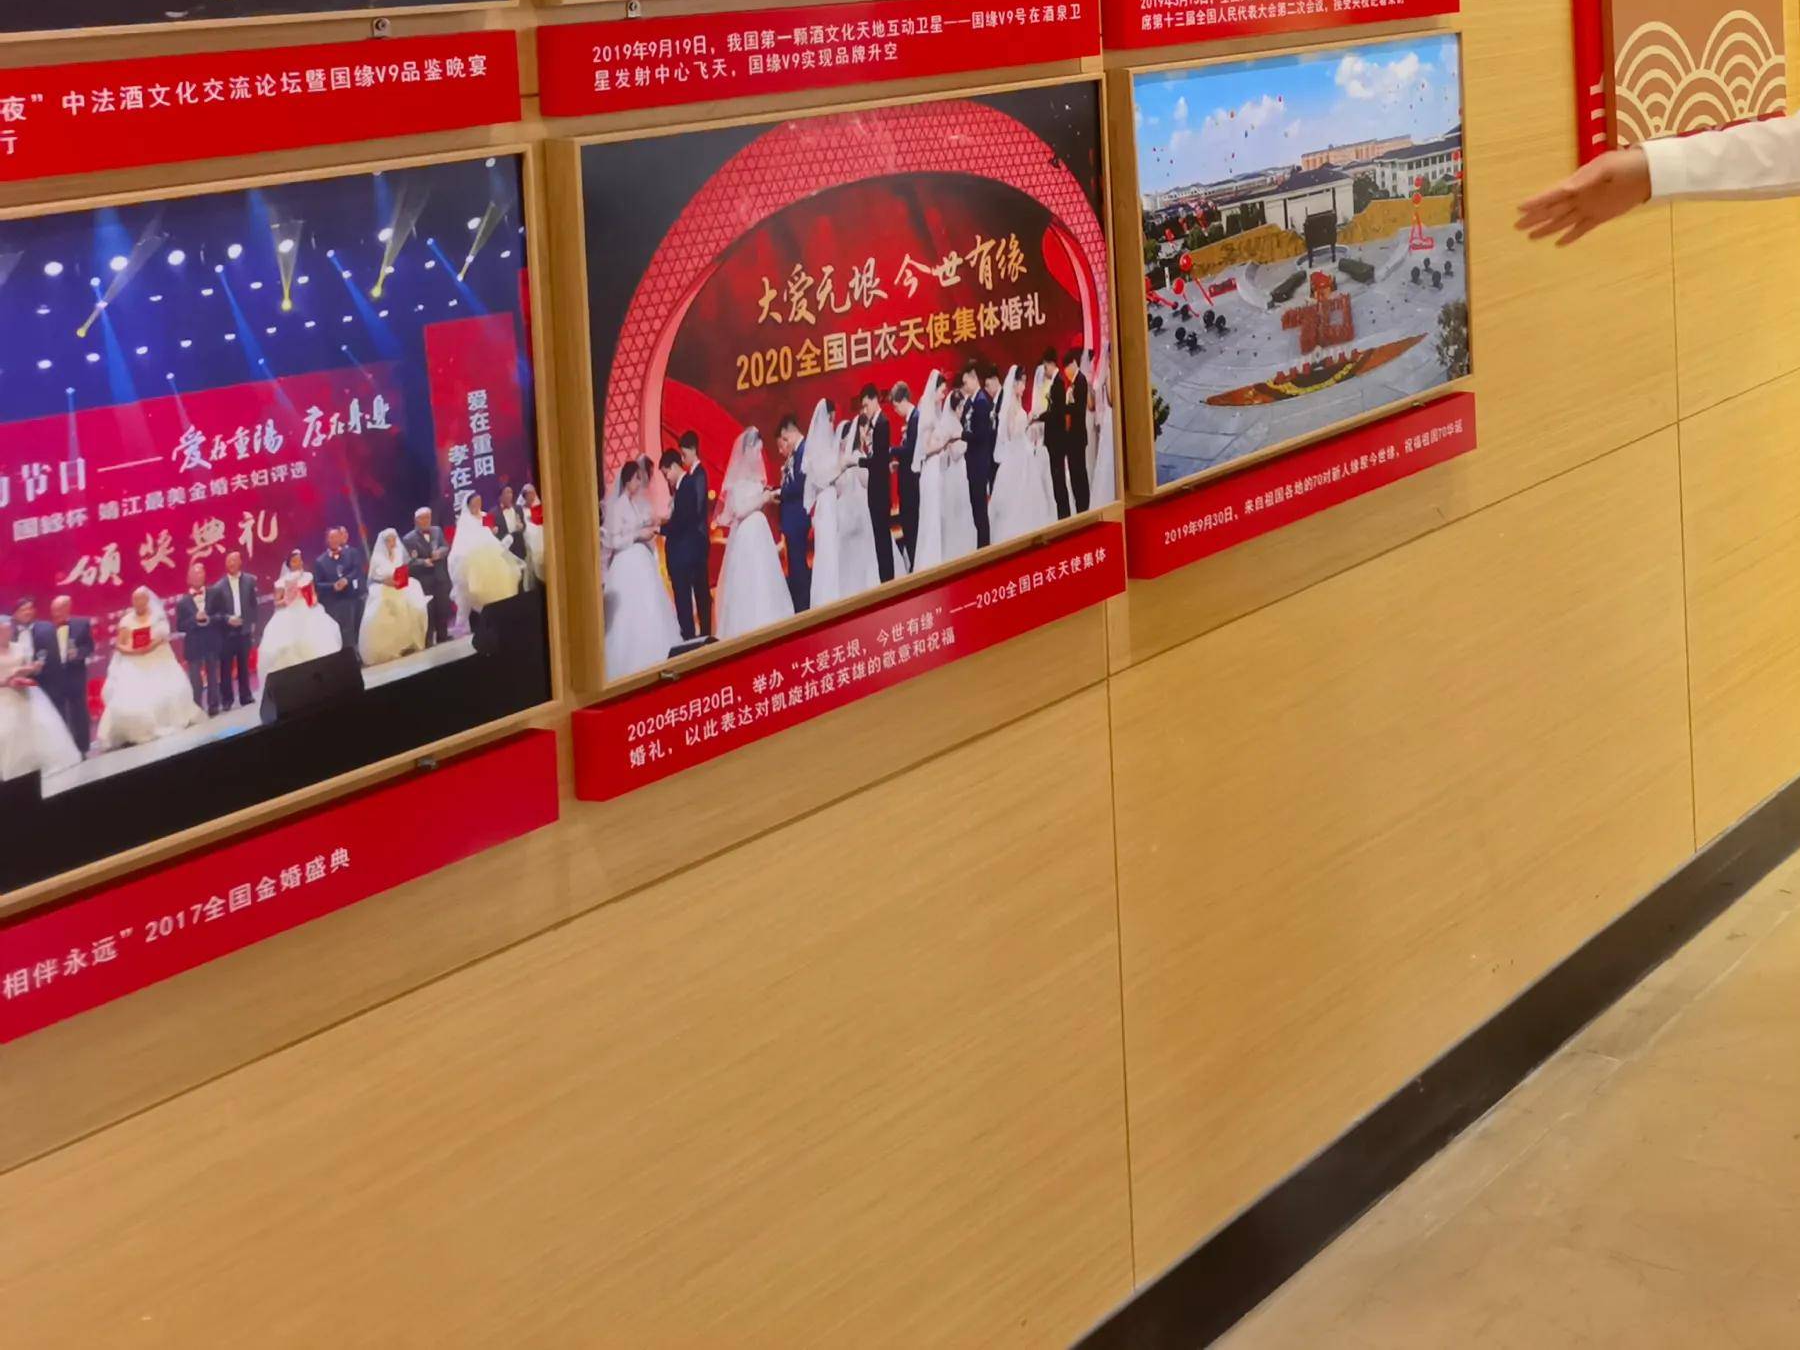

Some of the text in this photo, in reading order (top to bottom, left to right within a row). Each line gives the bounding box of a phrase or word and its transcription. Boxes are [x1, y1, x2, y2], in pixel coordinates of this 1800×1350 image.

[736, 292, 1046, 391] 2020全国白衣天使集体婚礼
